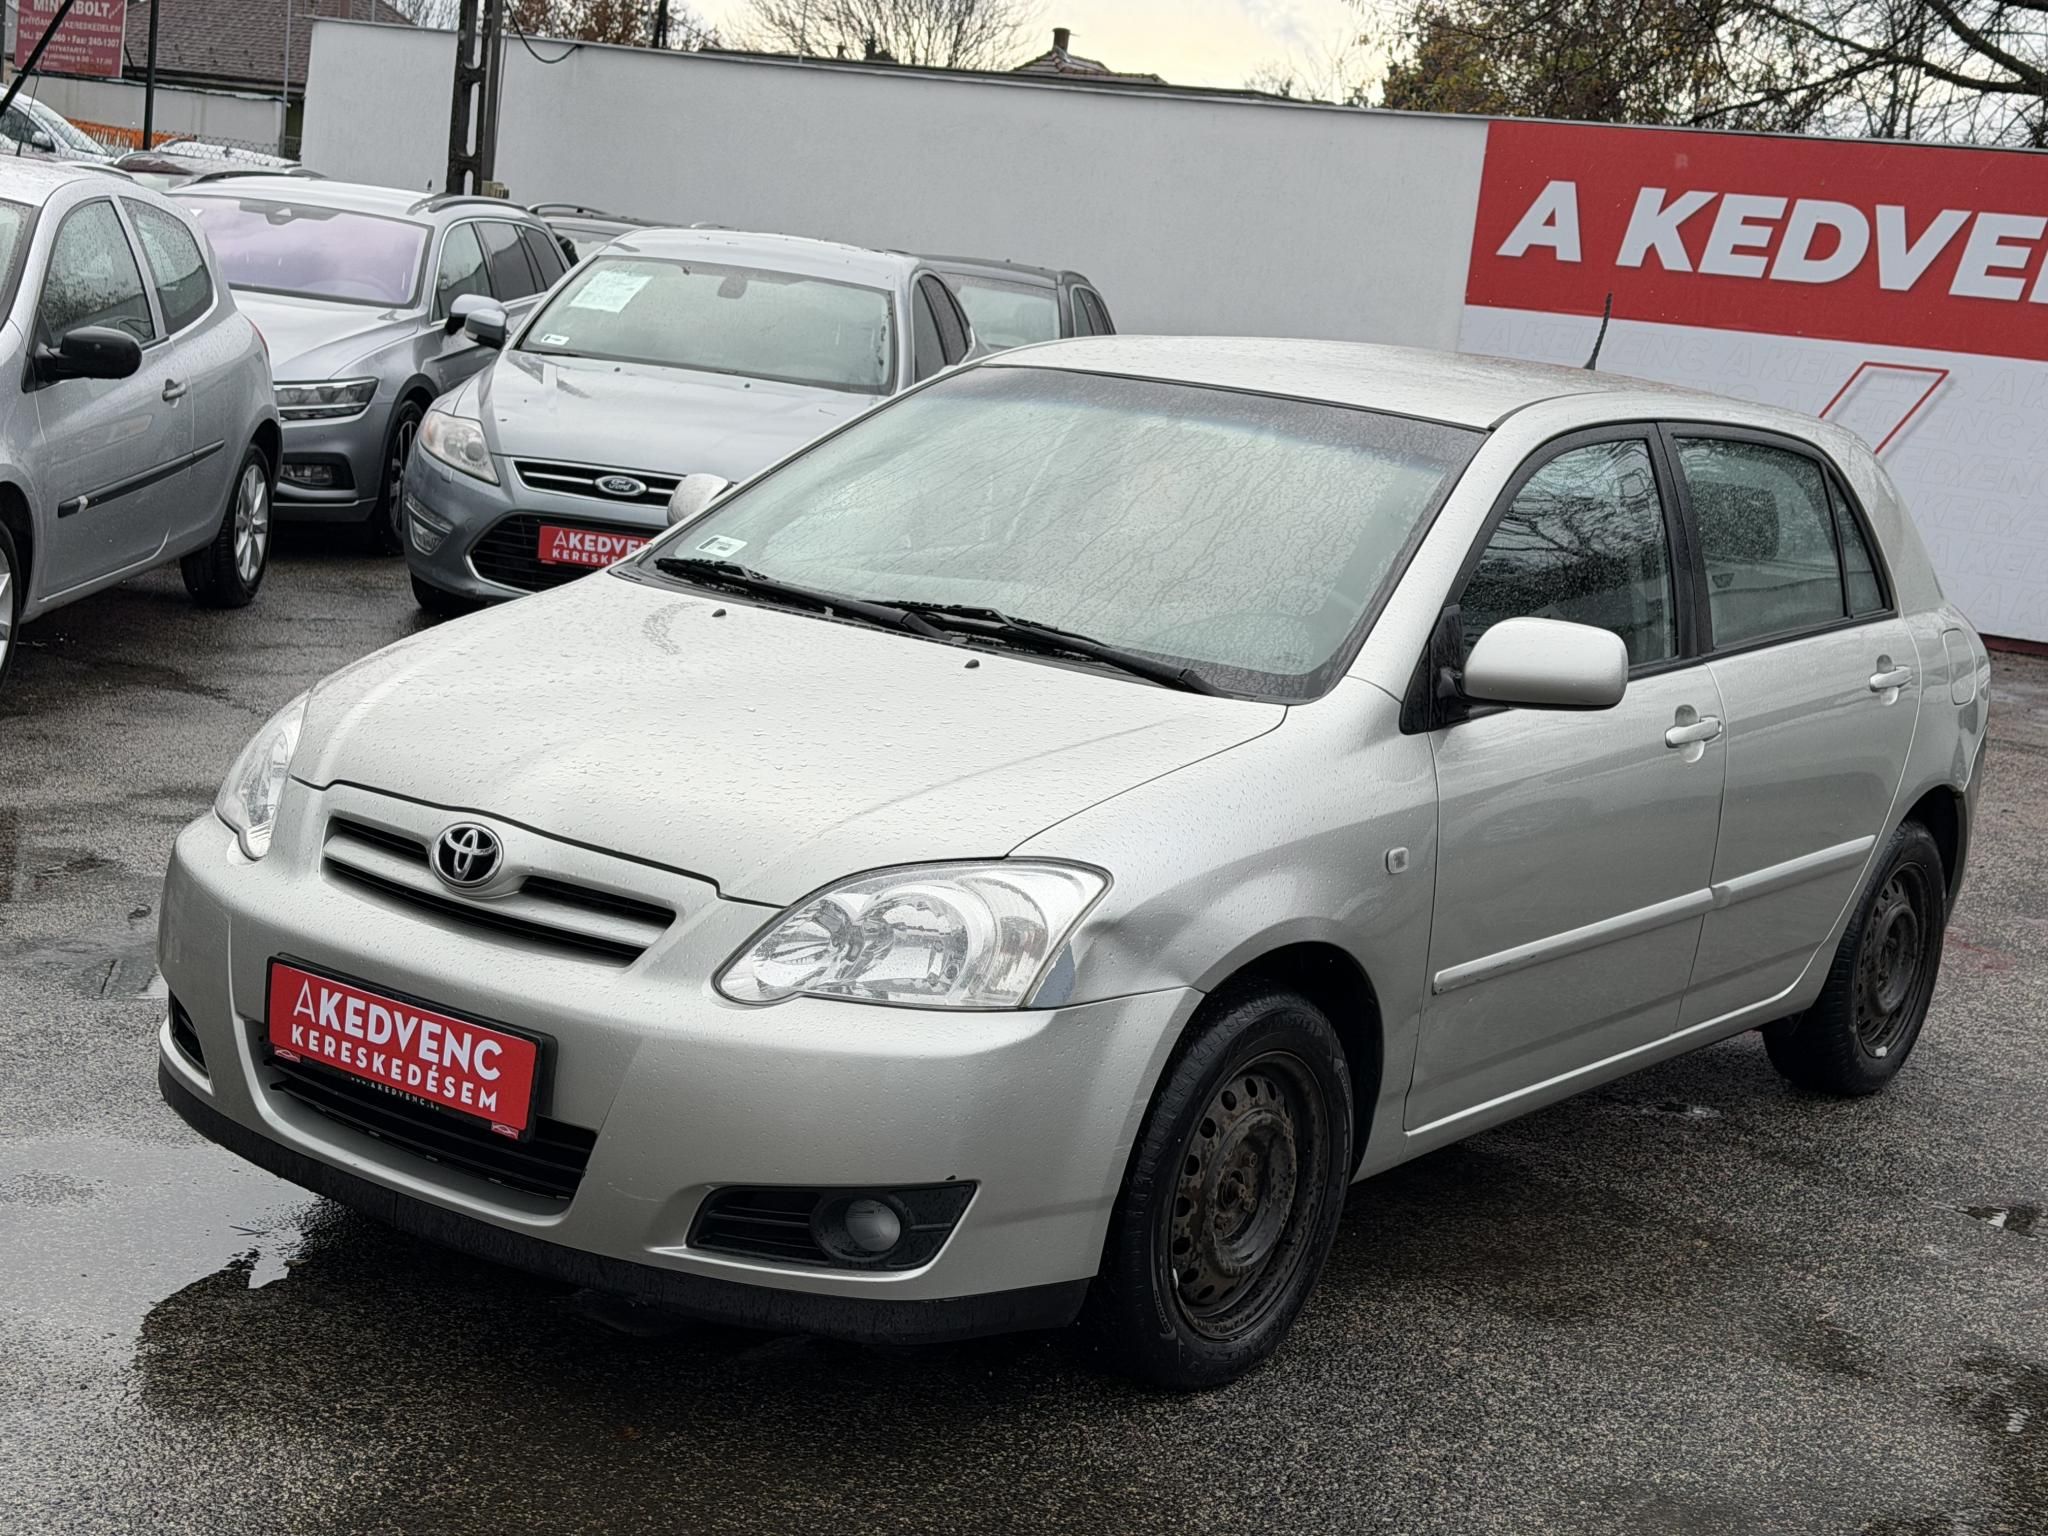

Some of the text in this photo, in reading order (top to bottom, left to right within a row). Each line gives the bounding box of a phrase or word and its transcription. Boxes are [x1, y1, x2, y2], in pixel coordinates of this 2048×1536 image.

[1496, 180, 1582, 262] A
[552, 547, 619, 565] KERESKE
[553, 529, 649, 555] AKEDVE
[291, 1023, 498, 1113] KERESKEDÉSEM
